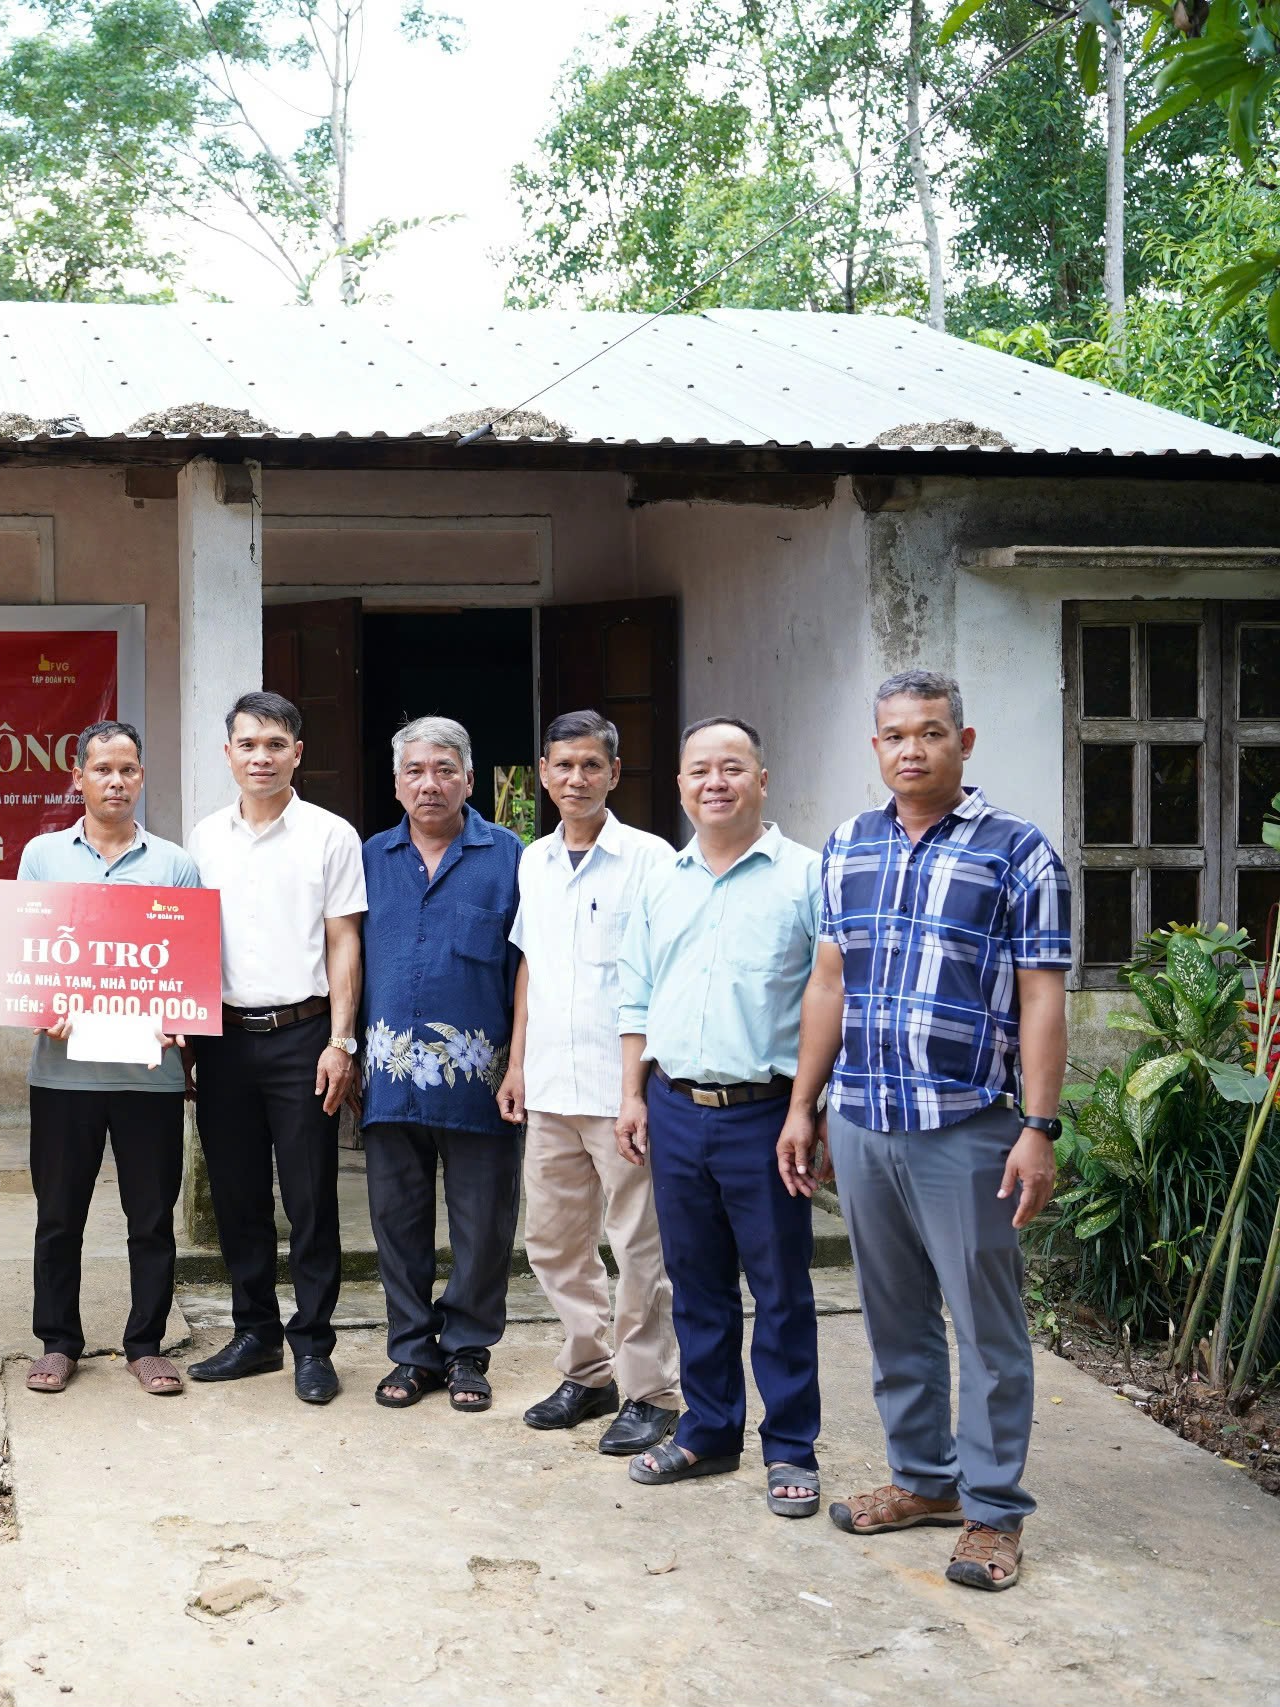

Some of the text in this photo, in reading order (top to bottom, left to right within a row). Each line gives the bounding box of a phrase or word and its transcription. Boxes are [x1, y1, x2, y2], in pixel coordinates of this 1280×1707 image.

[63, 676, 76, 684] FVG
[4, 793, 20, 807] DỘT
[44, 793, 63, 805] NĂM
[64, 794, 85, 805] 2025
[21, 925, 170, 975] HỖ TRỢ
[5, 971, 184, 994] XÓA NHÀ TẠM, NHÀ DỘT NÁT
[5, 994, 45, 1014] TIỀN:
